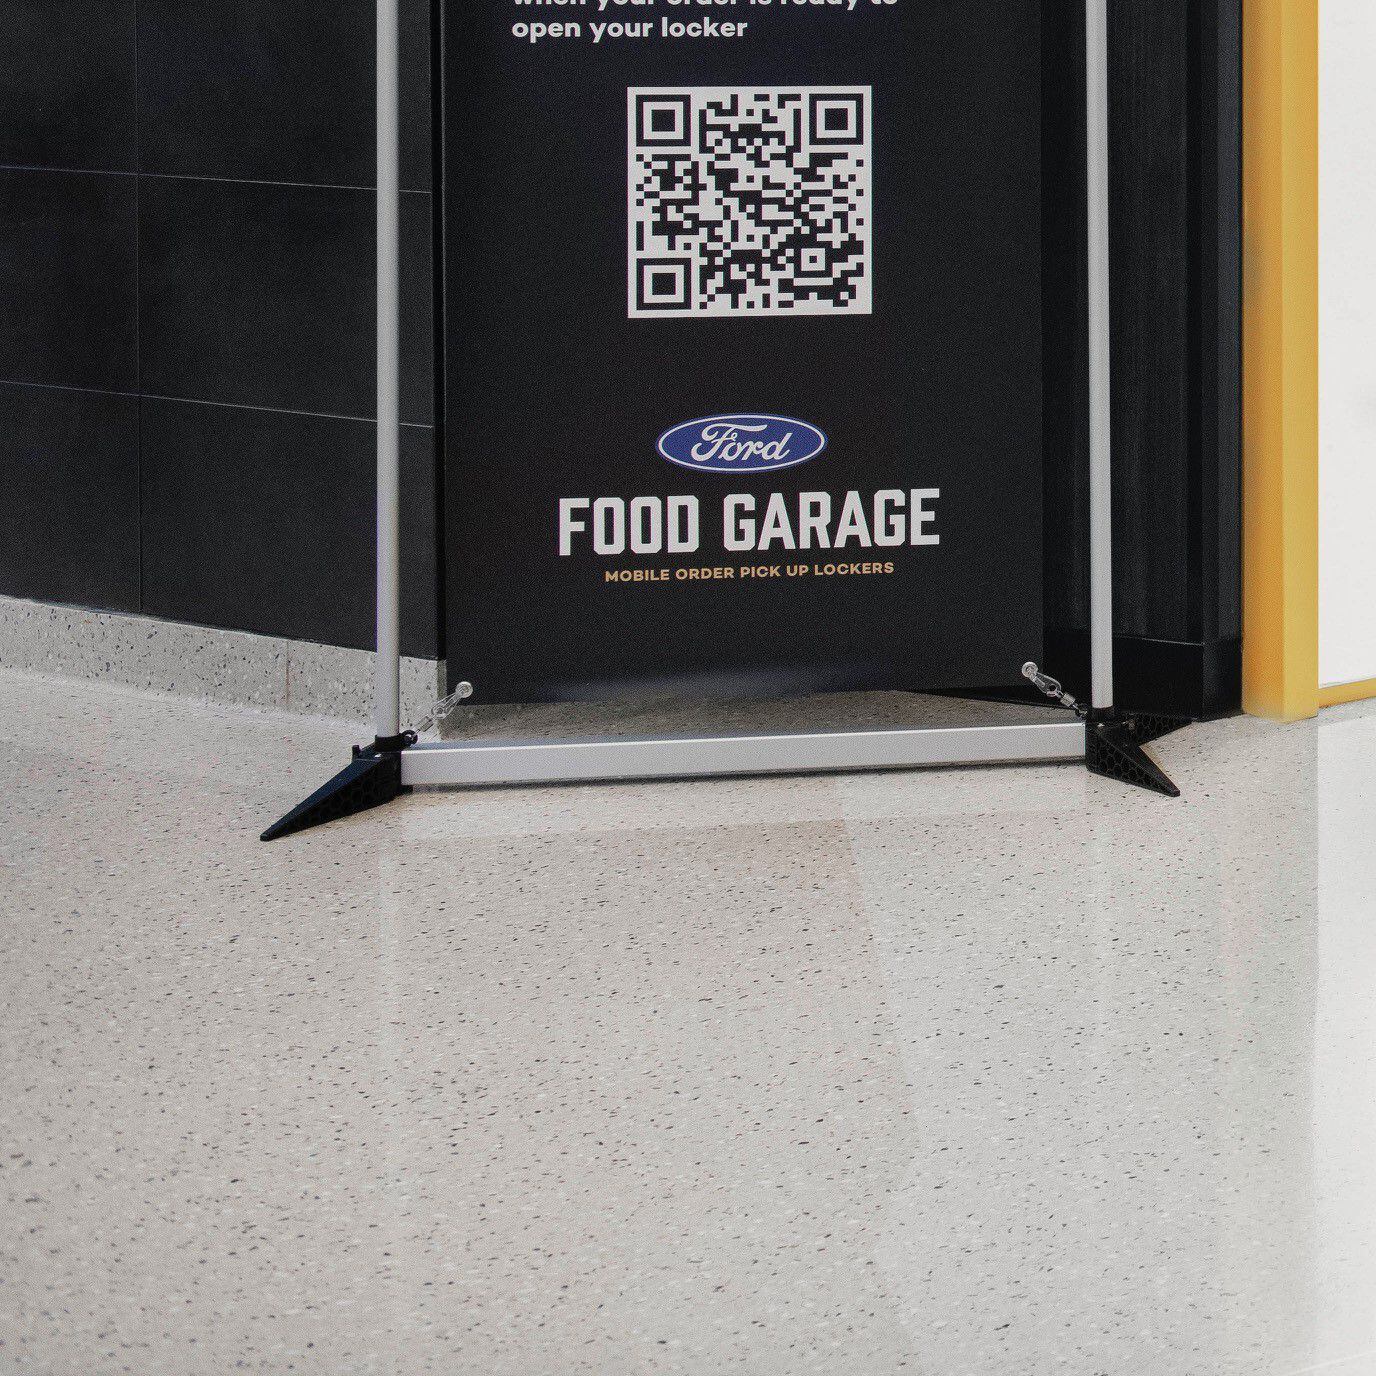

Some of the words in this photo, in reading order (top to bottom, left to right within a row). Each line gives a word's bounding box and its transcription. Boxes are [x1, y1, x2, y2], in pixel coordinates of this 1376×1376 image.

[512, 22, 580, 43] open
[589, 23, 654, 42] your
[661, 18, 747, 38] locker
[691, 423, 792, 462] Ford
[559, 495, 699, 556] FOOD
[723, 488, 940, 551] GARAGE
[605, 569, 669, 582] MOBILE
[676, 567, 734, 580] ORDER
[740, 565, 781, 578] PICK
[786, 564, 809, 576] UP
[815, 562, 894, 576] LOCKERS
